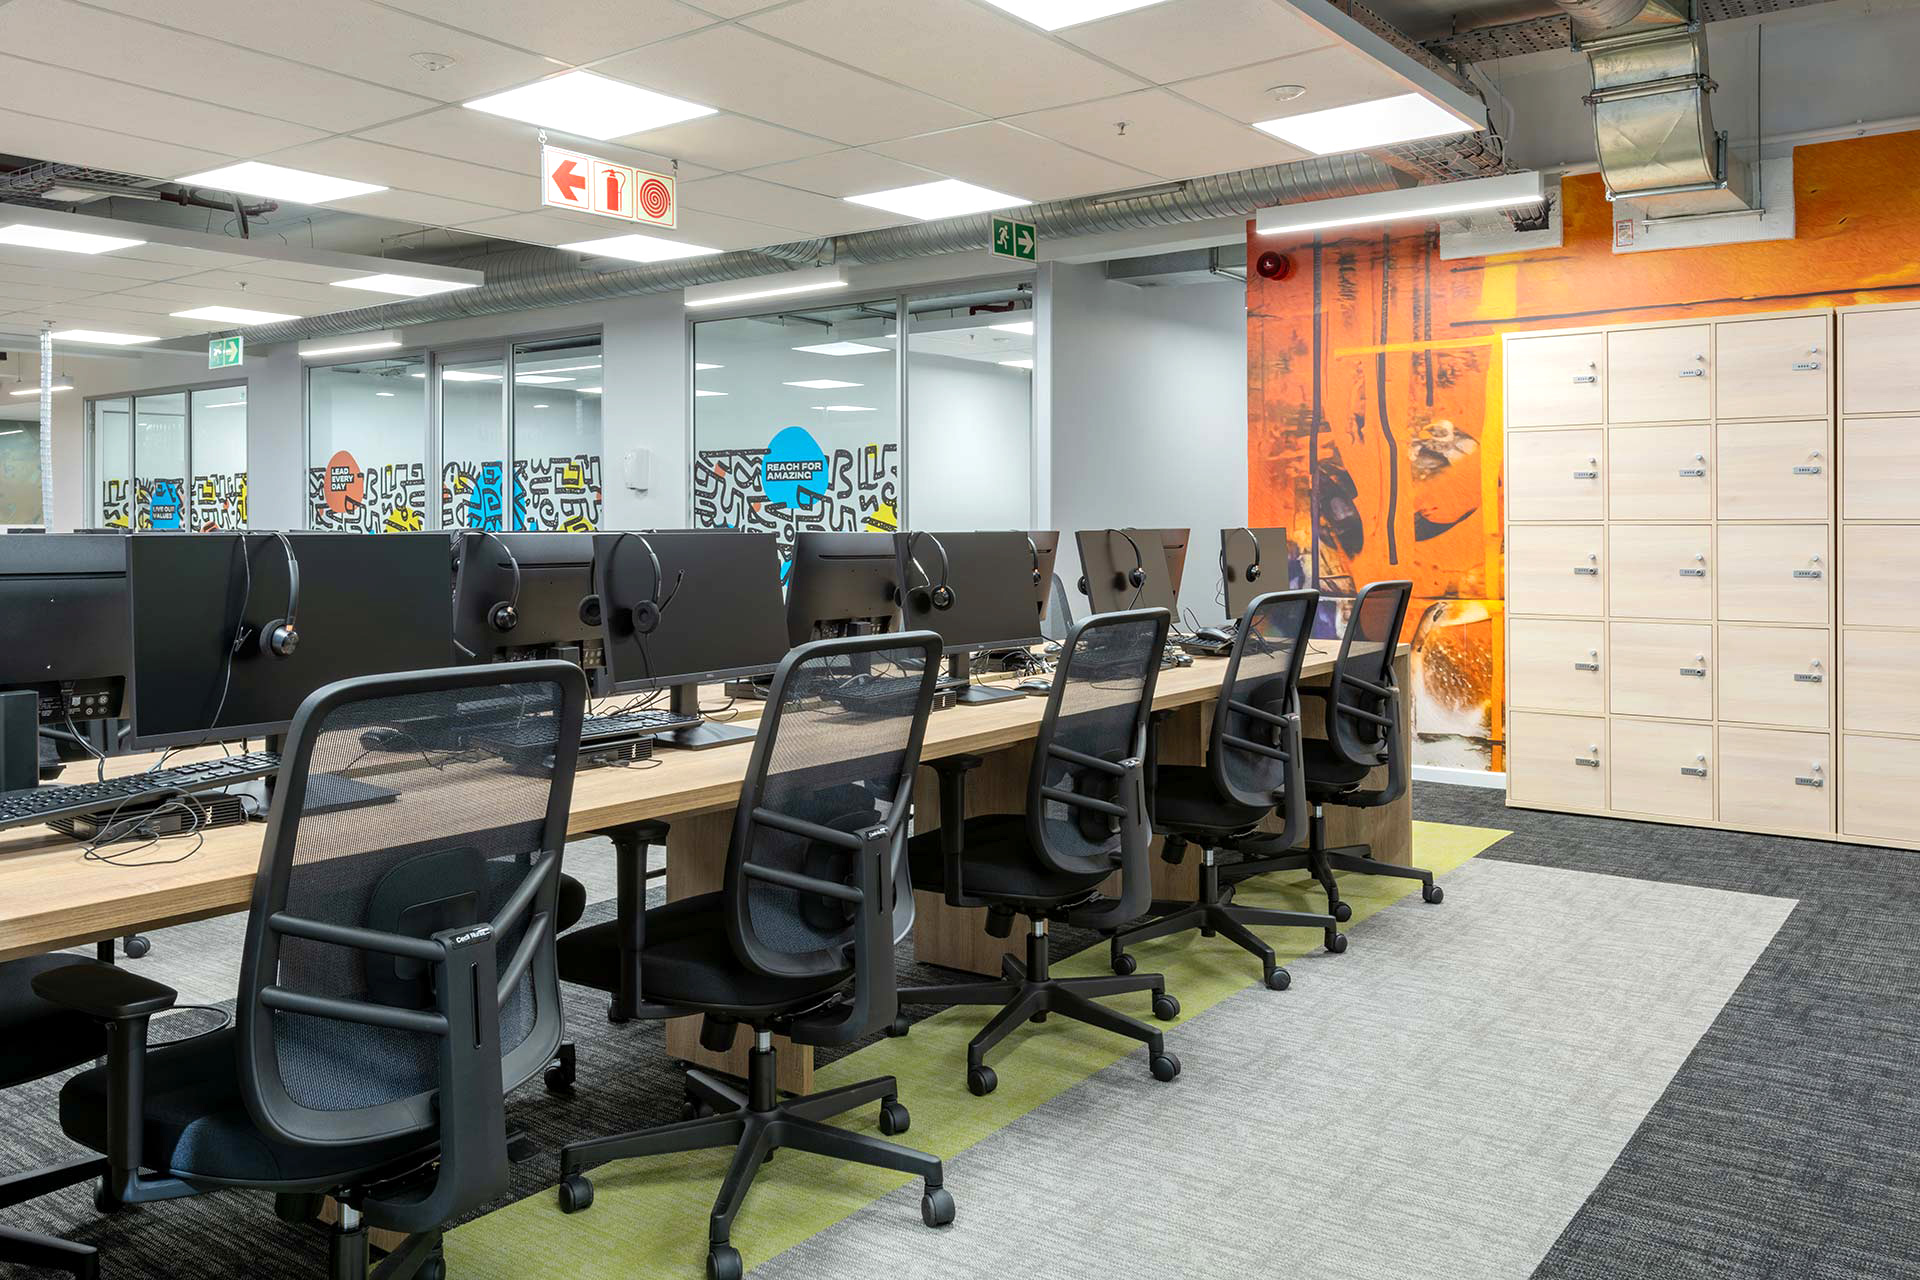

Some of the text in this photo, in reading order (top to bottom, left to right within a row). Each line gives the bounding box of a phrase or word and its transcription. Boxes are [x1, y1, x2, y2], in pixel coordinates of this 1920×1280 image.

[767, 462, 822, 471] REACH FOR
[767, 472, 811, 480] AMAZING
[205, 806, 213, 824] DELL
